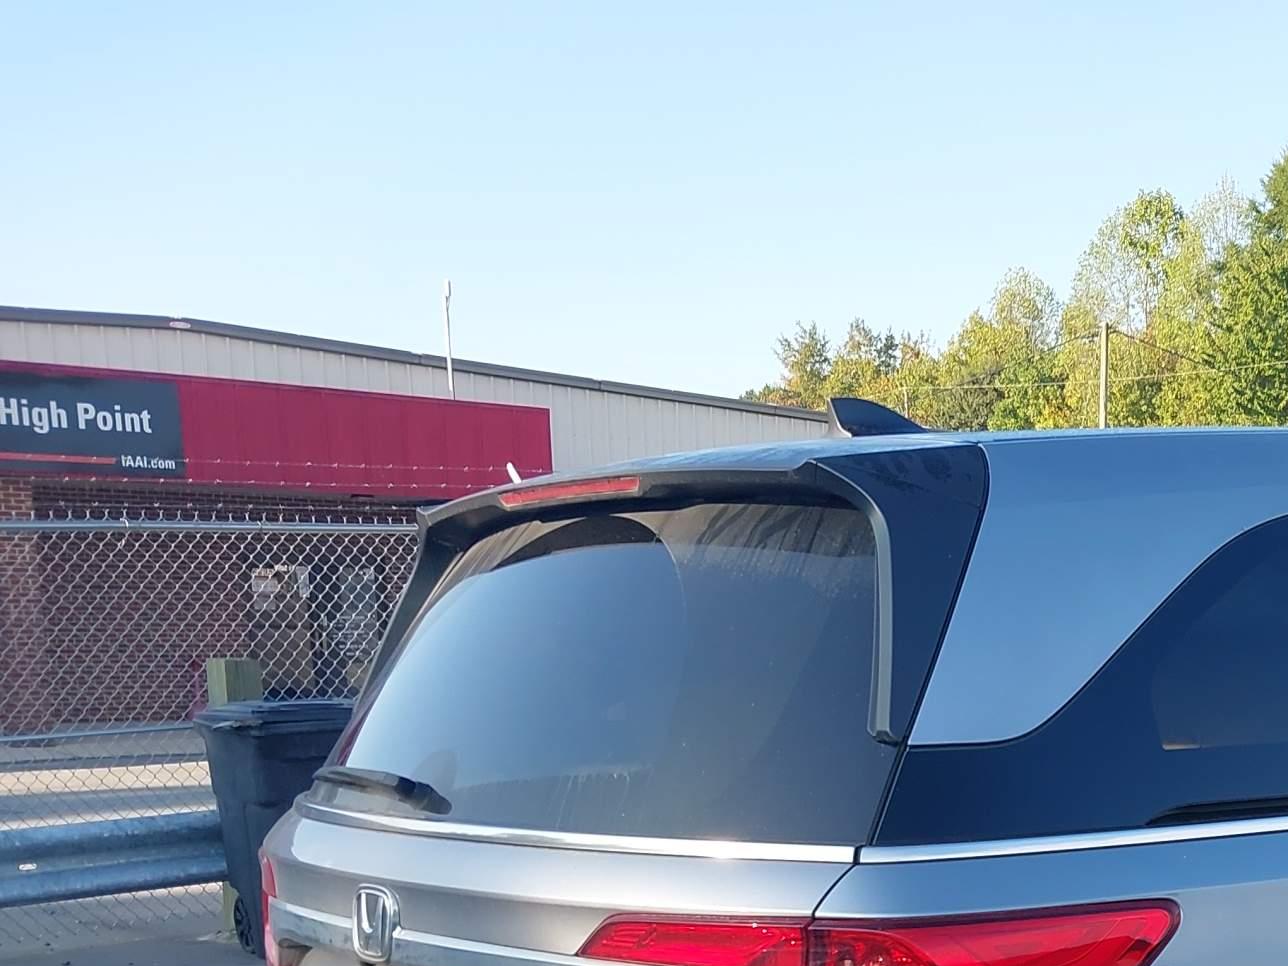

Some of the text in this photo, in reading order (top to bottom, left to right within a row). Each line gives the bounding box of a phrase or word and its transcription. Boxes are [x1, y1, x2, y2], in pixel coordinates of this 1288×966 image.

[0, 397, 152, 434] High Point
[121, 454, 176, 470] IAAI.com
